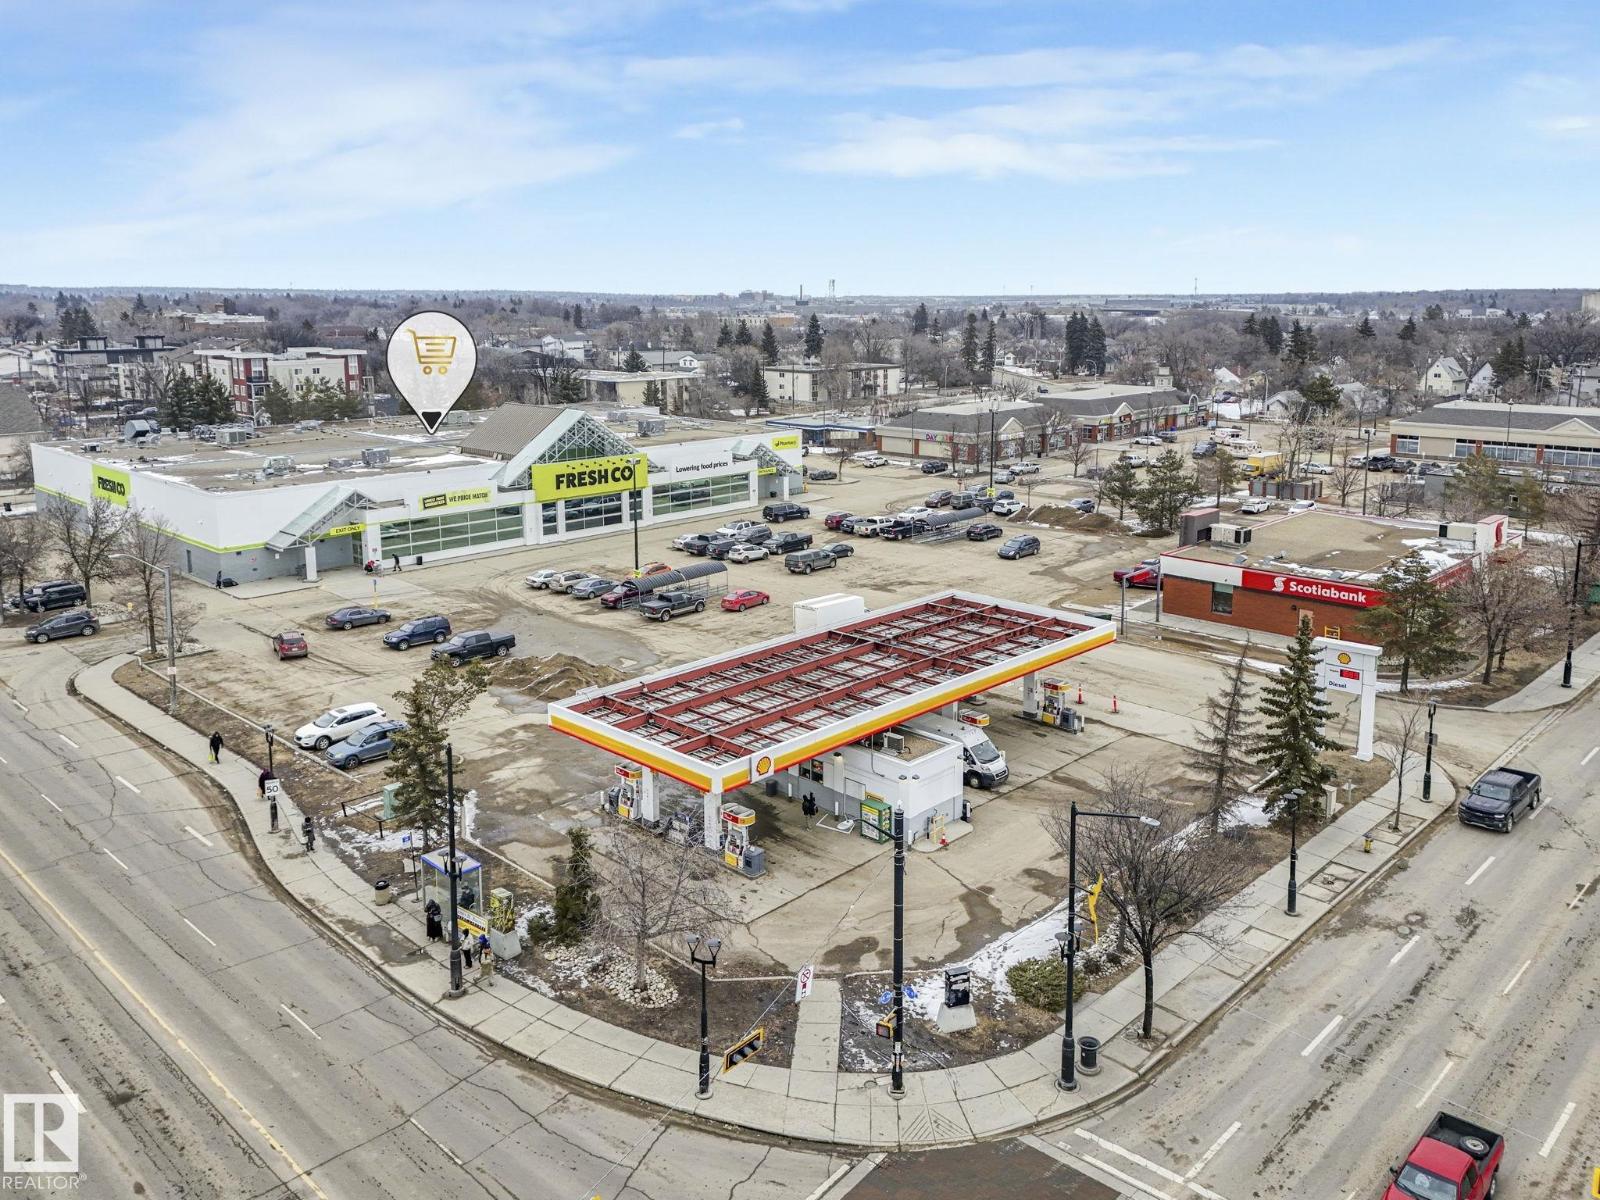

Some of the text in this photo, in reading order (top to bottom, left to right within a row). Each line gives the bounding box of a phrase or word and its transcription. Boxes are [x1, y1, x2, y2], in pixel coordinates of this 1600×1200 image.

[676, 464, 700, 472] Lowering
[713, 461, 728, 469] prices
[1289, 581, 1367, 603] Scotiabank
[1328, 680, 1347, 689] Diesel
[266, 785, 279, 794] 50
